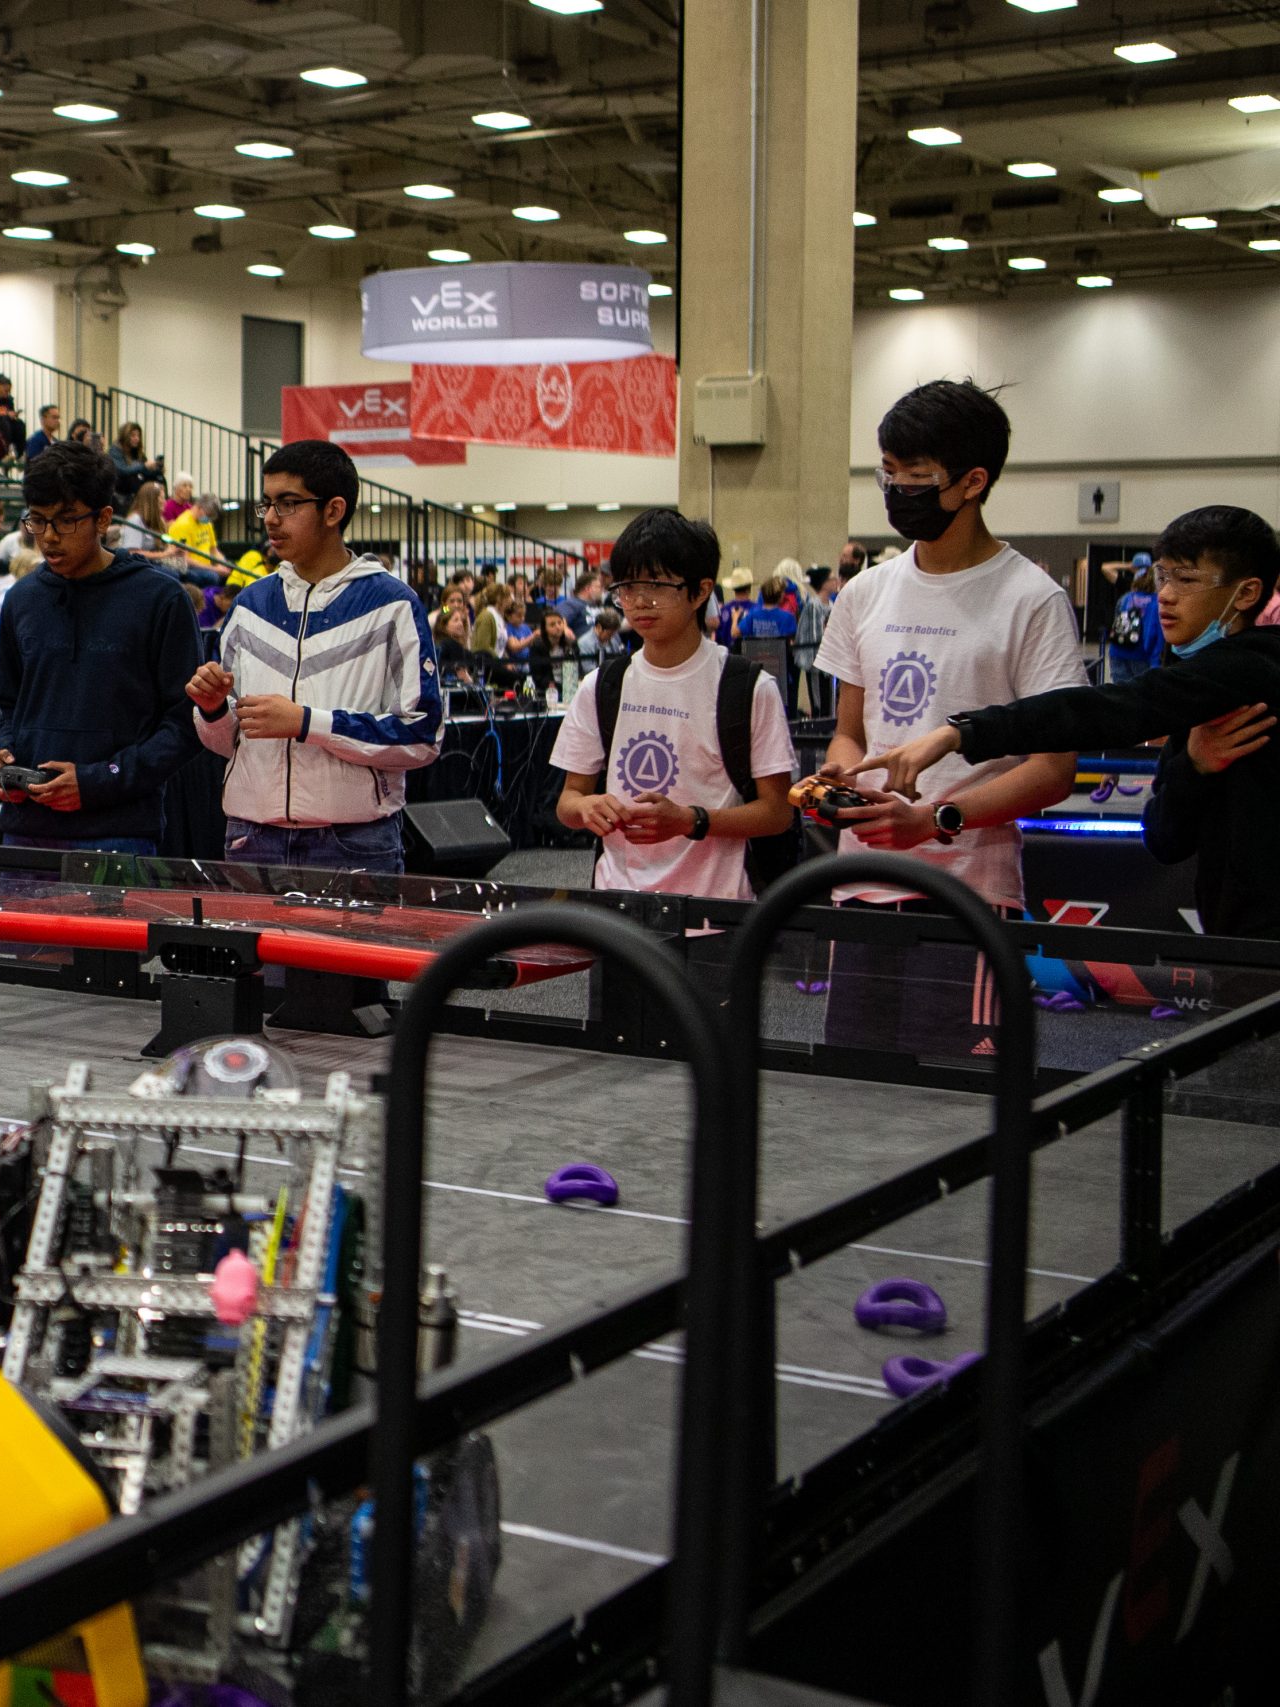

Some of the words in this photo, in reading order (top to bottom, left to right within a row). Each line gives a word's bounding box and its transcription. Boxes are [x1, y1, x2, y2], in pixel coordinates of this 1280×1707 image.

[410, 281, 496, 316] VEX
[411, 314, 498, 332] WORLDS
[338, 388, 406, 418] VEX
[884, 623, 913, 634] Blaze
[913, 625, 958, 637] Robotics
[621, 702, 648, 713] Blaze
[648, 704, 690, 719] Robotics
